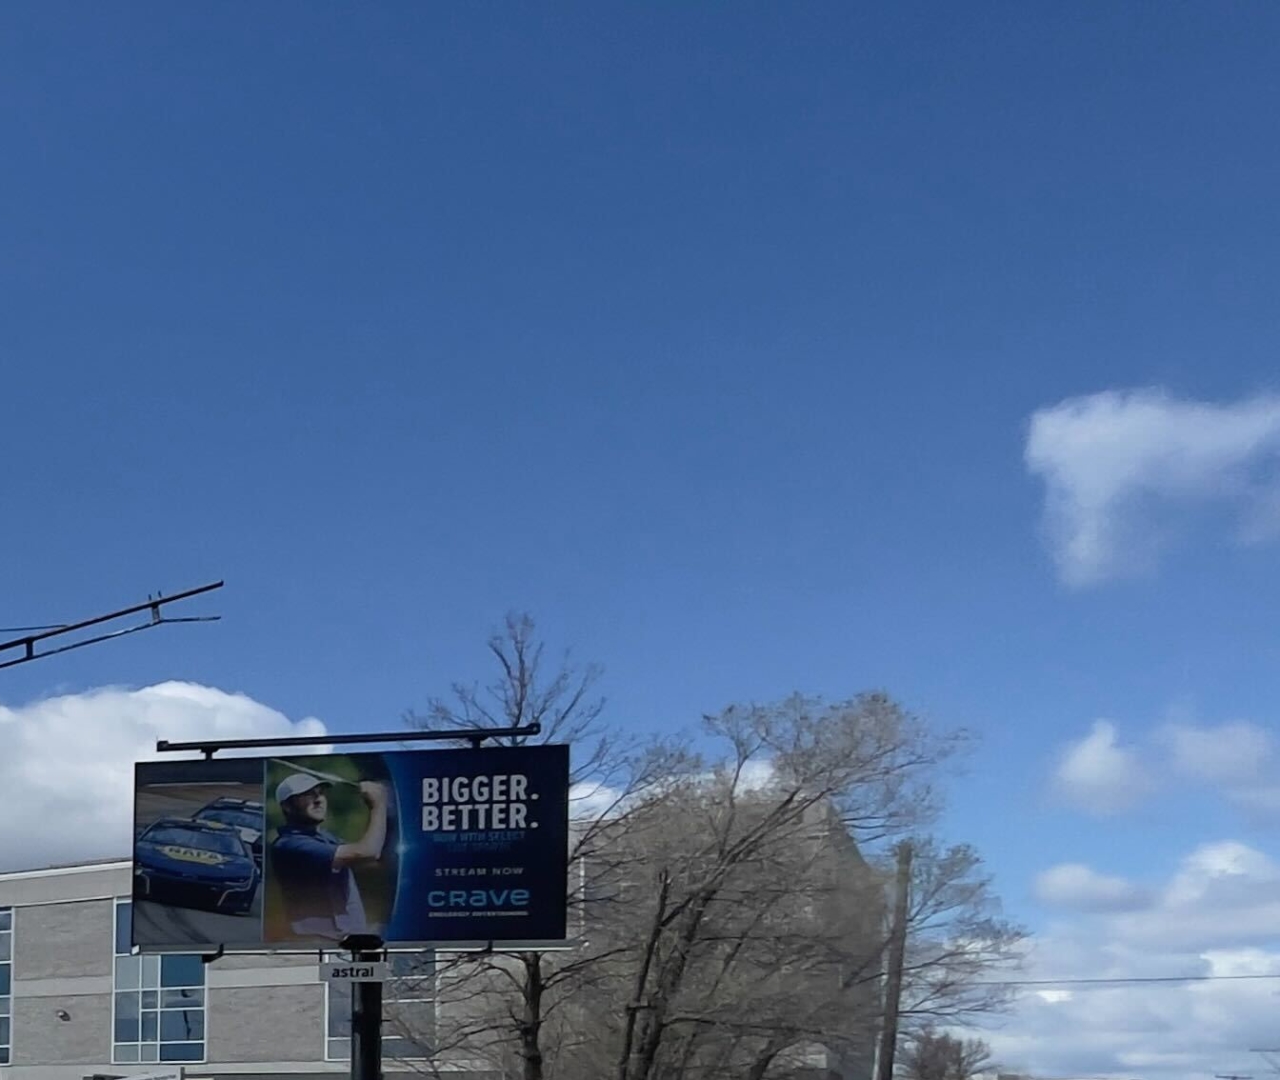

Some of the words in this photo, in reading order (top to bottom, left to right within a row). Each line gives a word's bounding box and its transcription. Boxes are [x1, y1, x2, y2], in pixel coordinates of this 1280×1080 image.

[422, 774, 539, 803] BIGGER.
[422, 803, 539, 831] BETTER.
[435, 868, 487, 876] STREAM
[492, 867, 524, 875] NOW
[331, 966, 374, 978] astral
